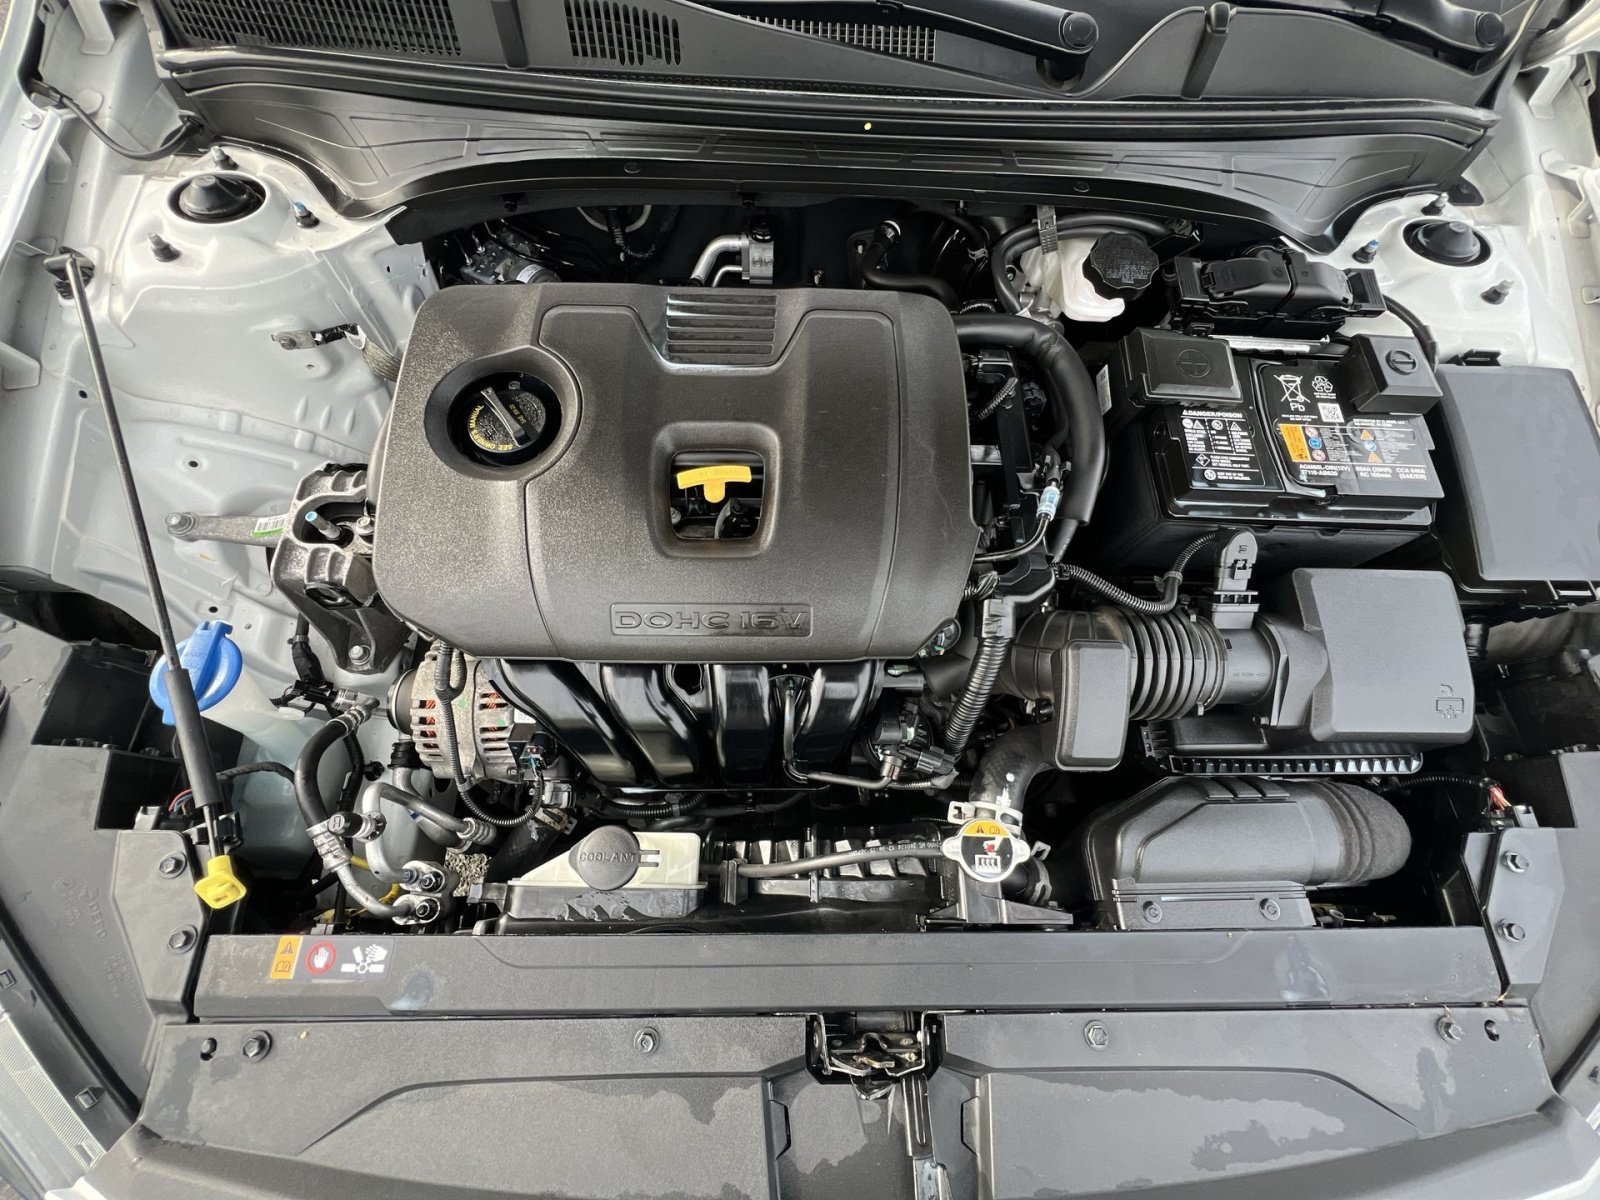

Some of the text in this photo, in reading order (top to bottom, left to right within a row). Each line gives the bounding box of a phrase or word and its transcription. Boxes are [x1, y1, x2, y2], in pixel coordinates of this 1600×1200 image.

[1290, 402, 1305, 412] Pb
[469, 405, 484, 429] MANUAL
[498, 443, 513, 451] SEE
[615, 611, 808, 630] DOHC 16V
[579, 851, 637, 863] COOLANT
